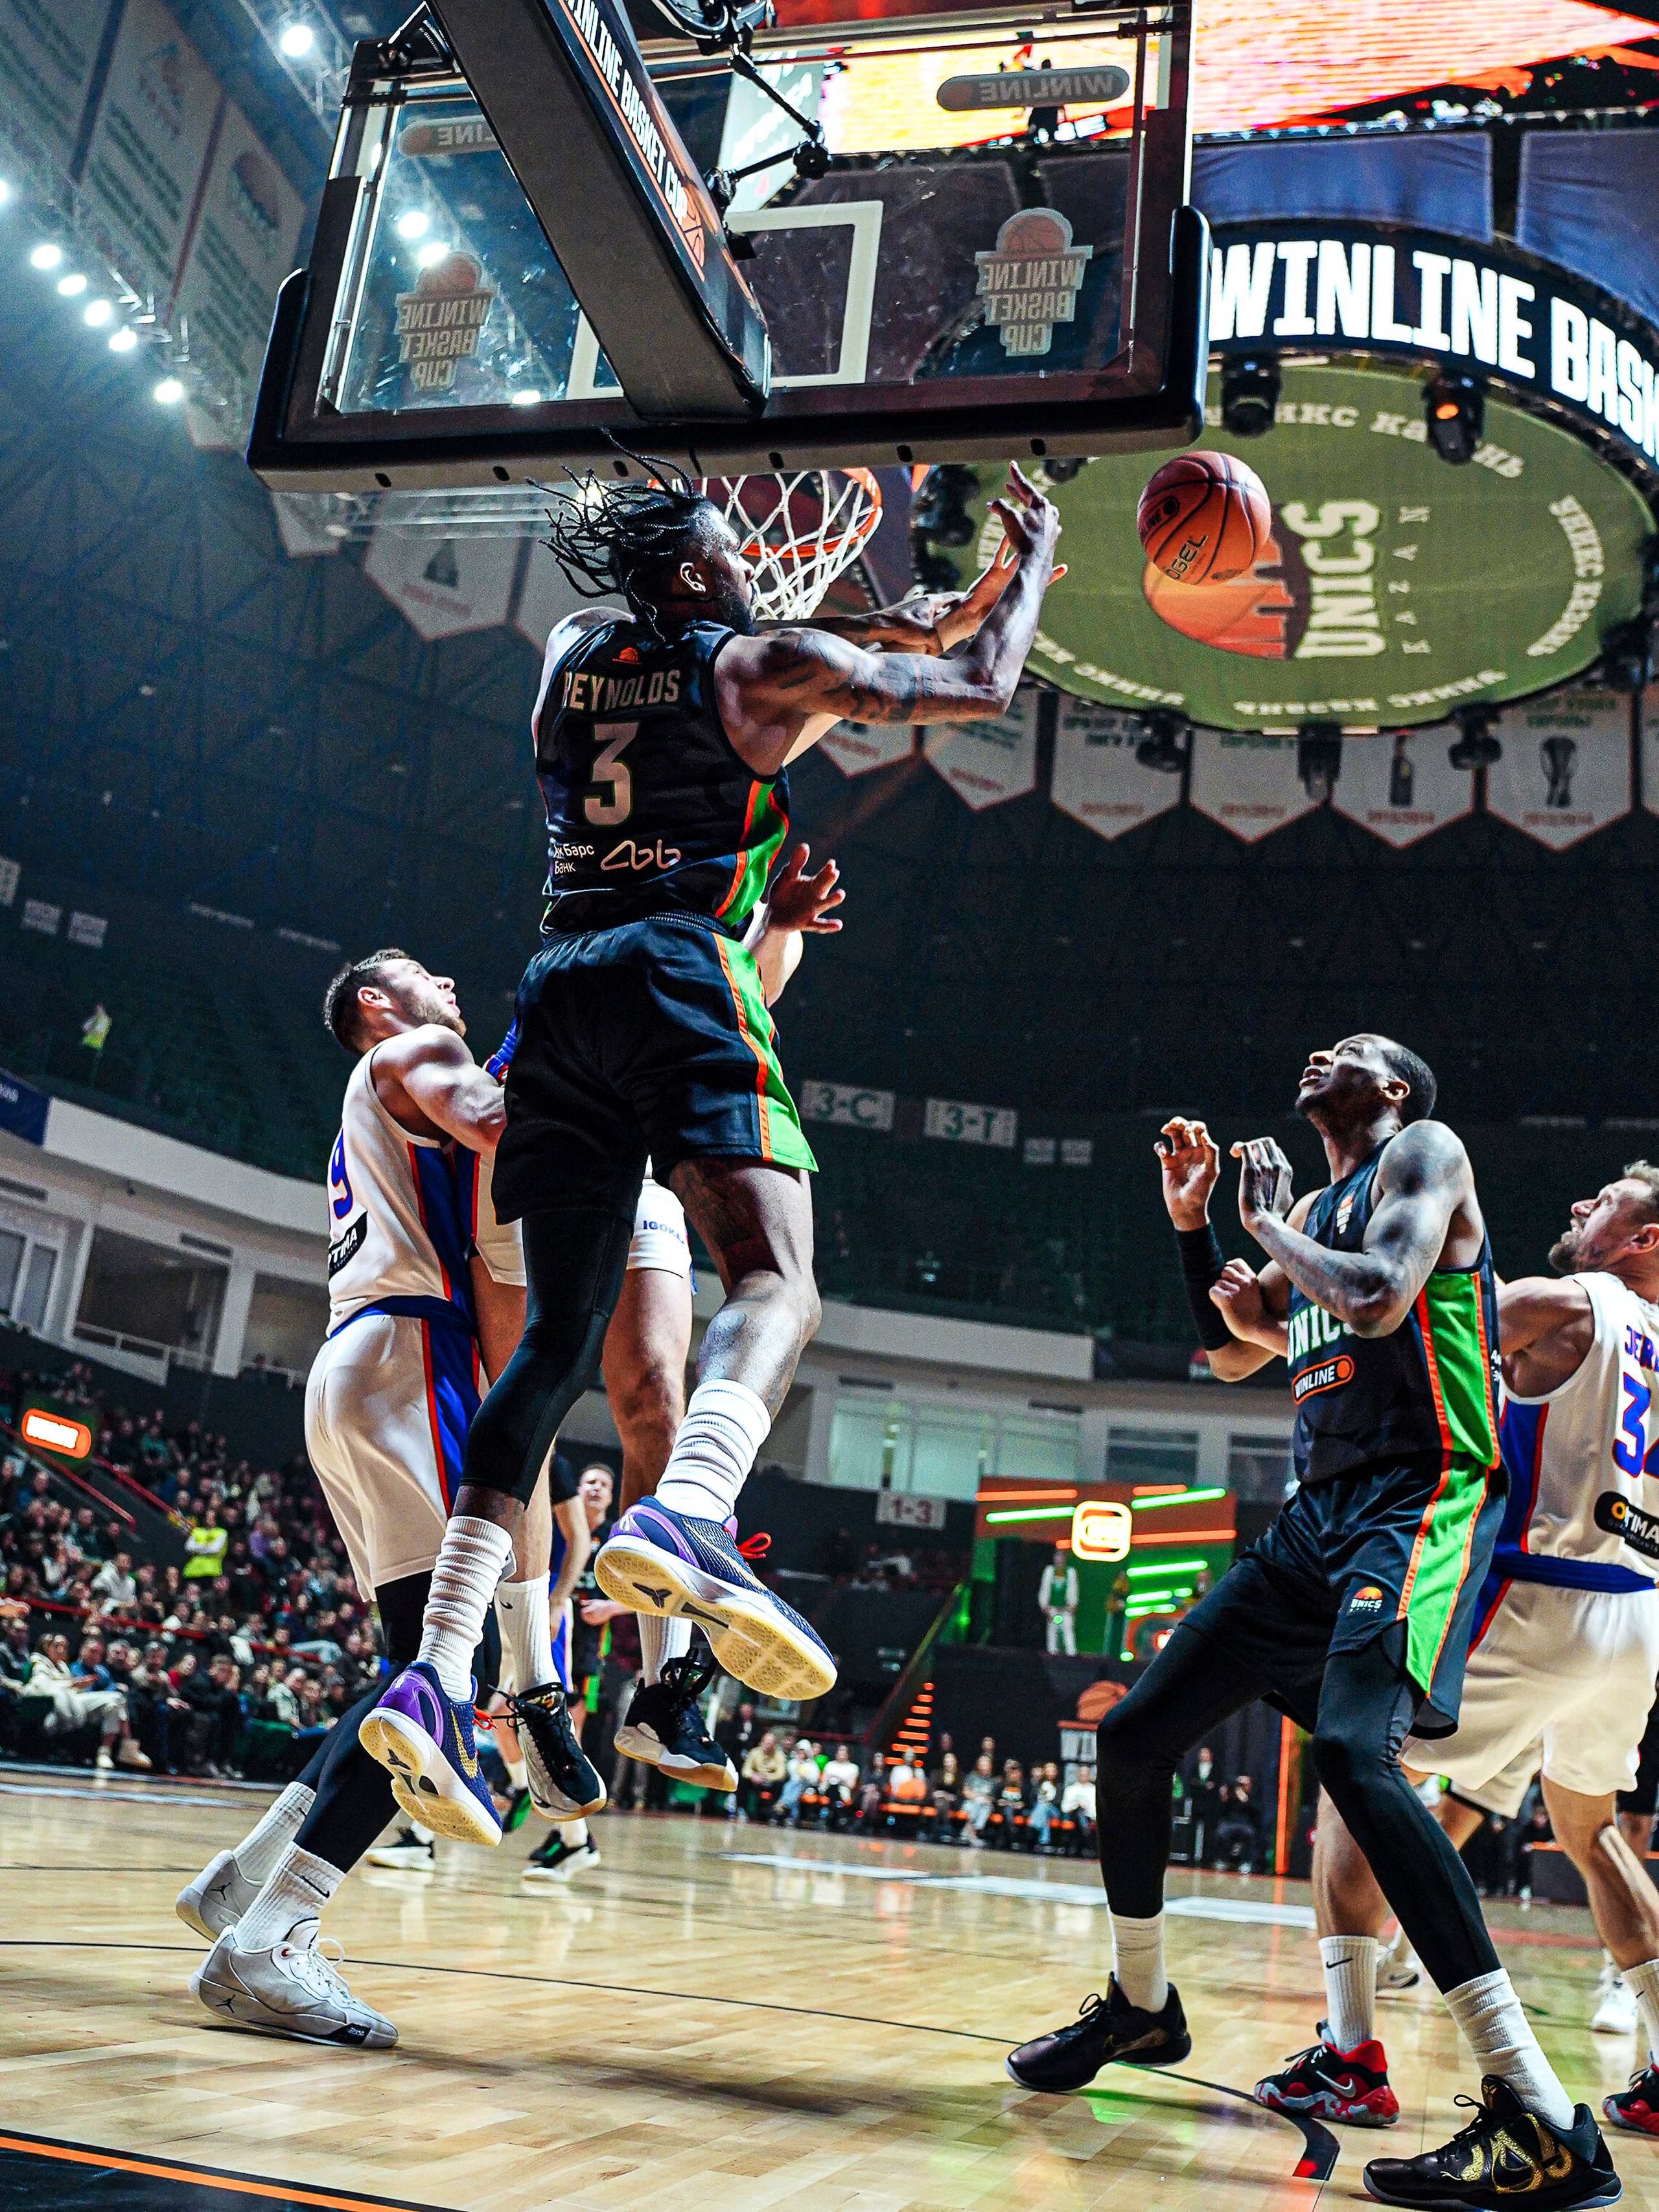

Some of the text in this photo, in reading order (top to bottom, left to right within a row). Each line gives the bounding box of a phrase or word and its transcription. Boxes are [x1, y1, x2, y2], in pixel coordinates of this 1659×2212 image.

[620, 69, 667, 184] BASKET
[664, 160, 689, 226] CUP
[1208, 240, 1536, 379] WINLINE
[1280, 498, 1386, 658] UNICS
[584, 721, 639, 827] 3
[555, 861, 576, 875] Банк
